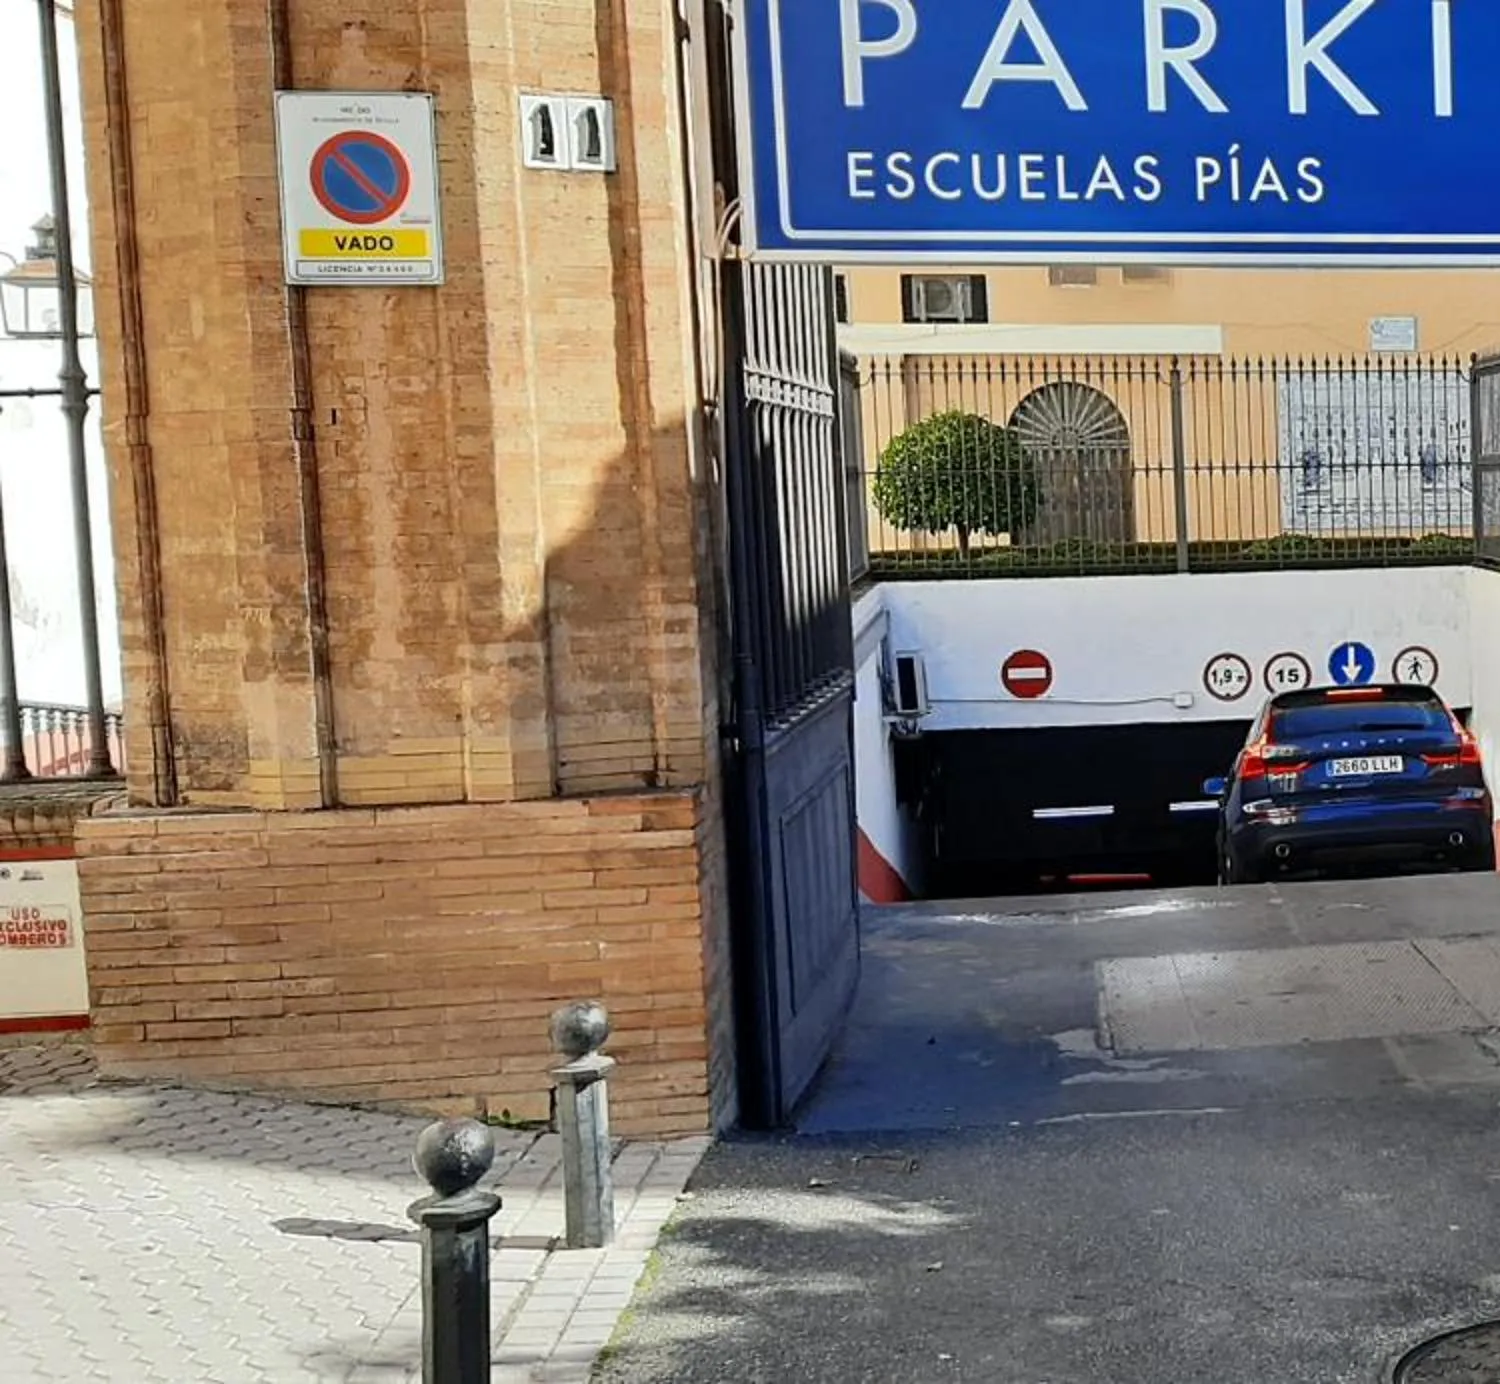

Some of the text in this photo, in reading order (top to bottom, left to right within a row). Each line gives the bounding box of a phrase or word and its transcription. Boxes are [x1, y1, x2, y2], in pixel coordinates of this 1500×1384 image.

[846, 143, 1326, 204] ESCUELAS PÍAS
[334, 235, 394, 251] VADO
[318, 265, 363, 273] LICENCIA
[1275, 668, 1300, 684] 15
[1335, 758, 1399, 773] 2660 LLH
[11, 907, 40, 921] USO
[0, 919, 67, 932] CLUSIVO
[0, 932, 67, 945] OMBEROS
